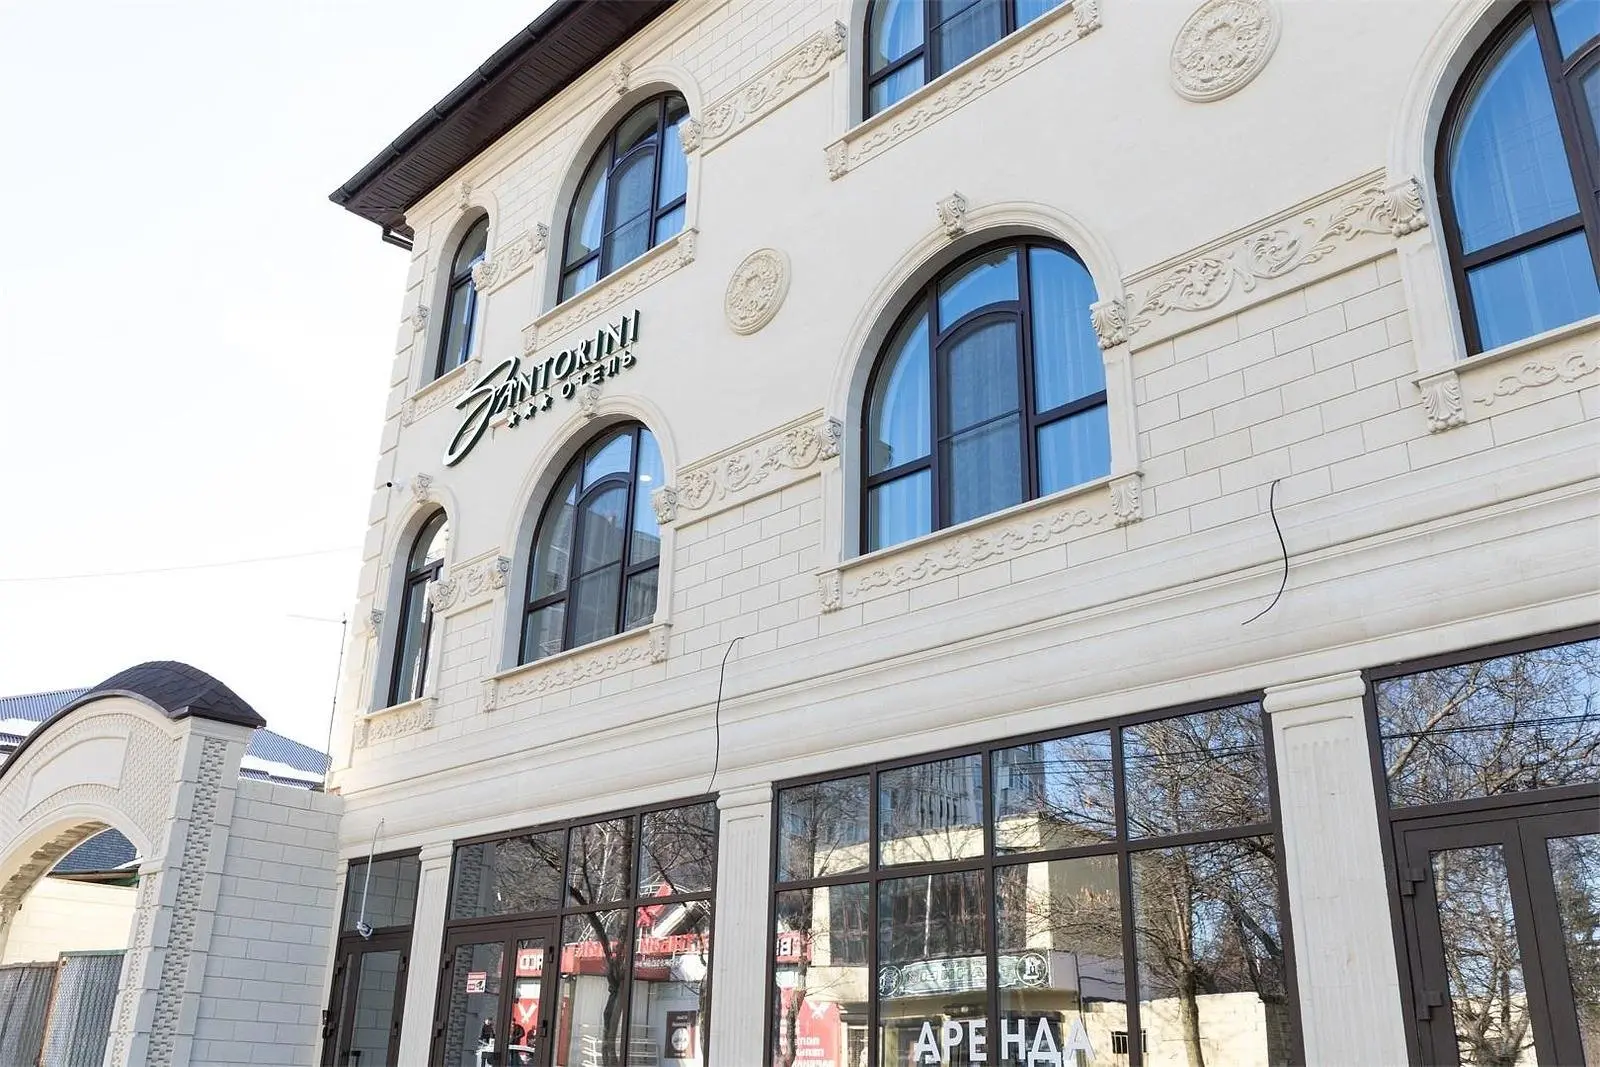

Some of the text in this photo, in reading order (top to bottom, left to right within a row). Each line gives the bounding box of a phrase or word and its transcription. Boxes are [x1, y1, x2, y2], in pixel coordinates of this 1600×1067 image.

[443, 309, 640, 466] SANTORINI
[562, 350, 636, 399] ОТЕЛЬ
[913, 1017, 1096, 1066] АРЕНДА
